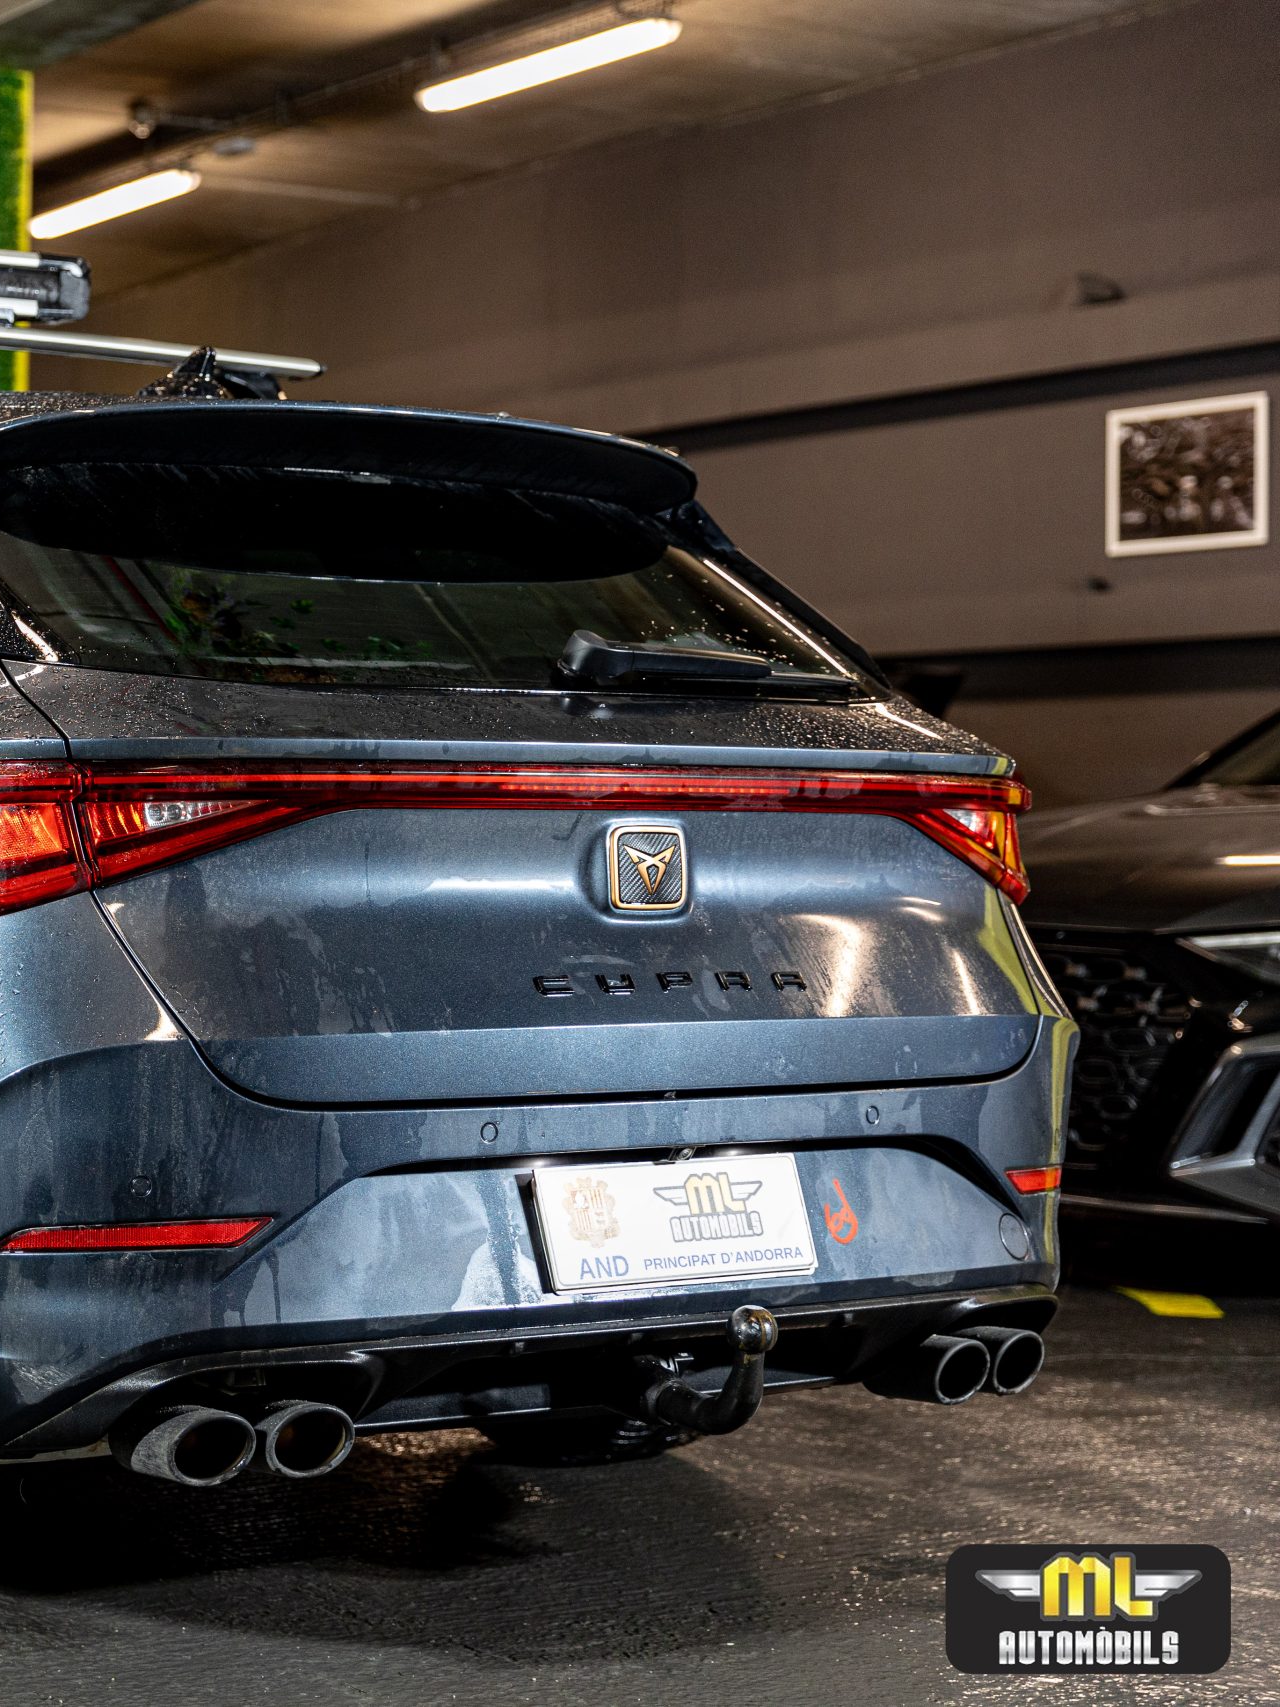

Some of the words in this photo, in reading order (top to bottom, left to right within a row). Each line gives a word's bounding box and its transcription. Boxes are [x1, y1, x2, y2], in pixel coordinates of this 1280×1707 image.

[532, 970, 808, 998] CUPRA
[684, 1172, 746, 1216] ML
[579, 1255, 629, 1280] AND
[643, 1252, 717, 1271] PRINCIPAT
[721, 1246, 804, 1265] D'ANDORRA
